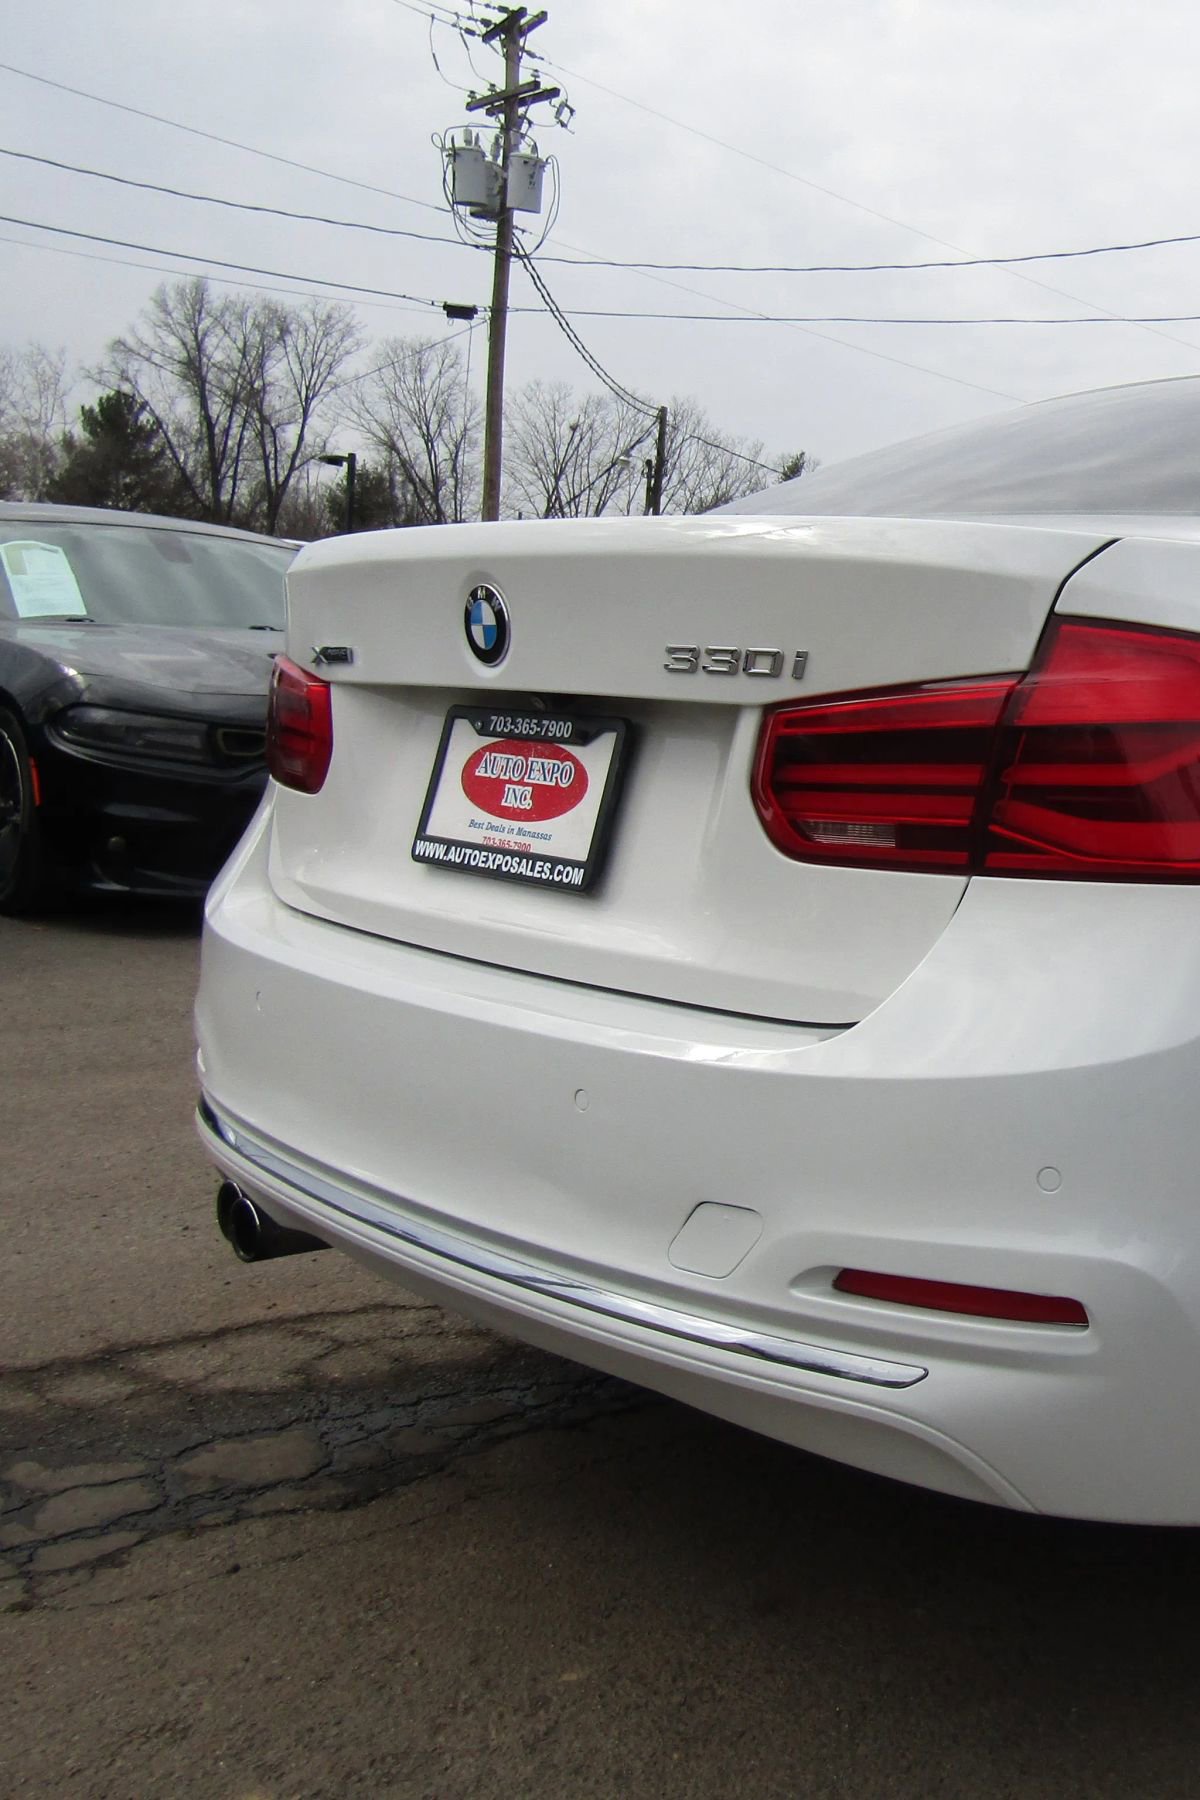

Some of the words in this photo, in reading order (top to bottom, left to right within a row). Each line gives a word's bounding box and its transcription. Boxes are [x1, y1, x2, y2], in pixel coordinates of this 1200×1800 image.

[664, 644, 808, 680] 330i
[489, 715, 573, 738] 703-365-7900
[475, 752, 526, 781] AUTO
[525, 757, 575, 788] EXPO
[501, 784, 534, 809] INC.
[468, 819, 485, 831] Best
[485, 822, 506, 834] Deals
[506, 825, 515, 835] in
[515, 827, 553, 841] Manassas
[482, 836, 532, 853] 703-365-7900
[415, 839, 585, 886] WWW.AUTOEXPOSALES.COM
